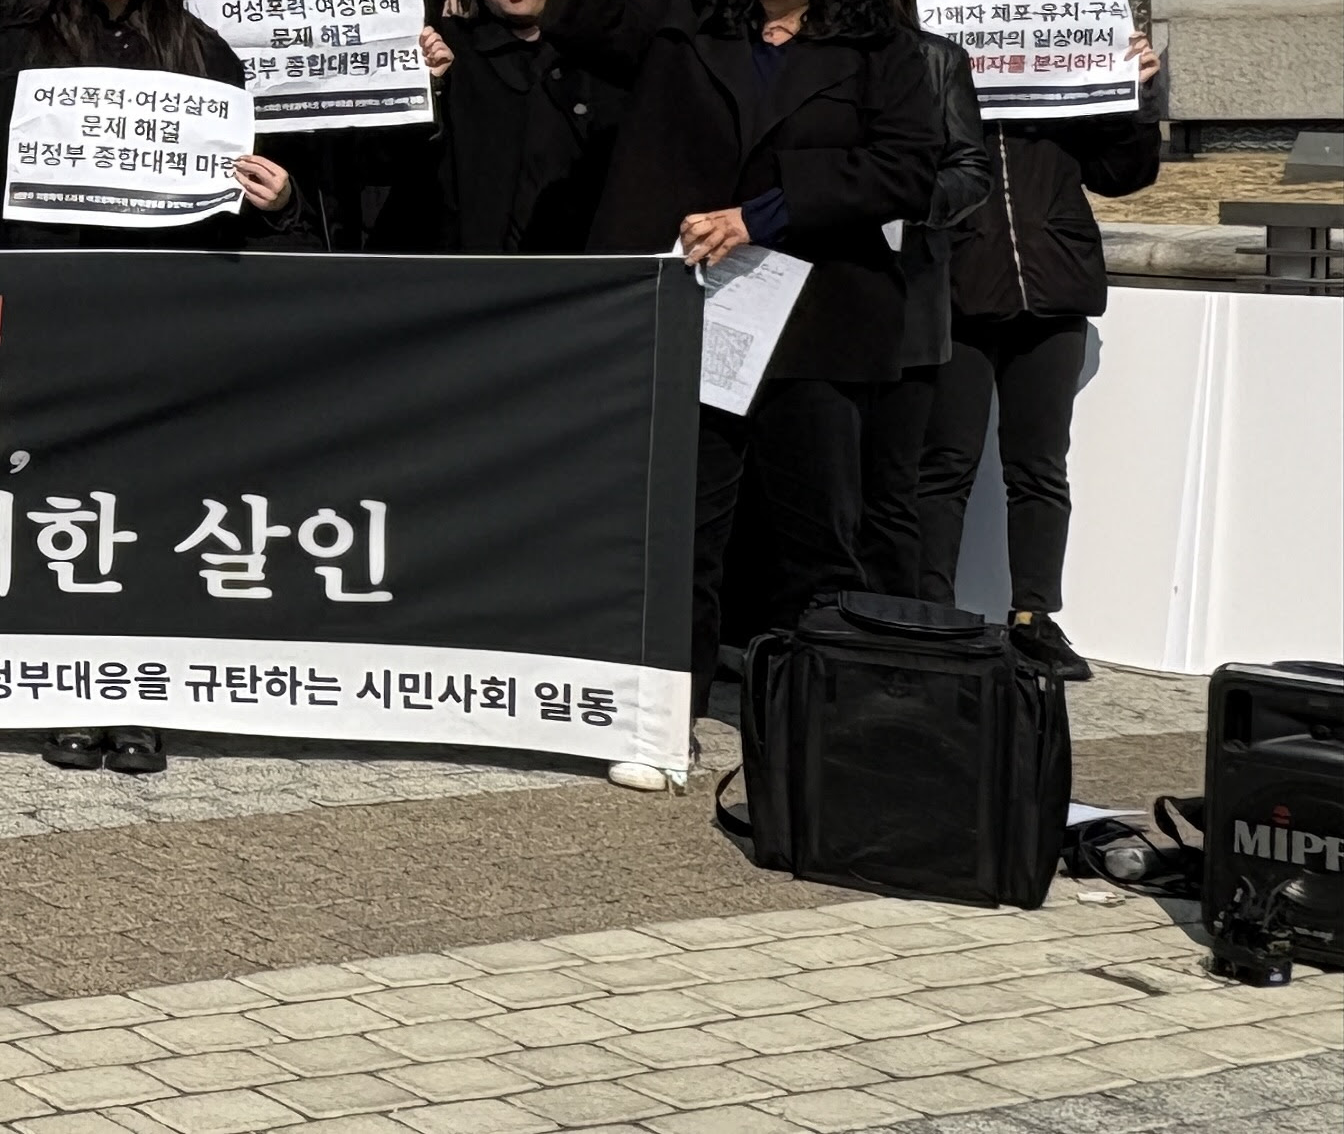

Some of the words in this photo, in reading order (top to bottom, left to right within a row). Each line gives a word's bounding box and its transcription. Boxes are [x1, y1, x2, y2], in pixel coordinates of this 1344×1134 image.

[270, 25, 313, 50] 문제
[320, 23, 361, 47] 해결
[284, 50, 371, 78] 종합대책
[376, 48, 421, 73] 마련
[34, 85, 230, 120] 여성폭력·여성살해
[80, 115, 127, 140] 문제
[134, 118, 181, 145] 해결
[17, 141, 87, 168] 범정부
[92, 145, 188, 176] 종합대책
[173, 493, 393, 603] 살인
[184, 664, 342, 706] 규탄하는
[356, 669, 516, 717] 시민사회
[534, 682, 617, 727] 일동
